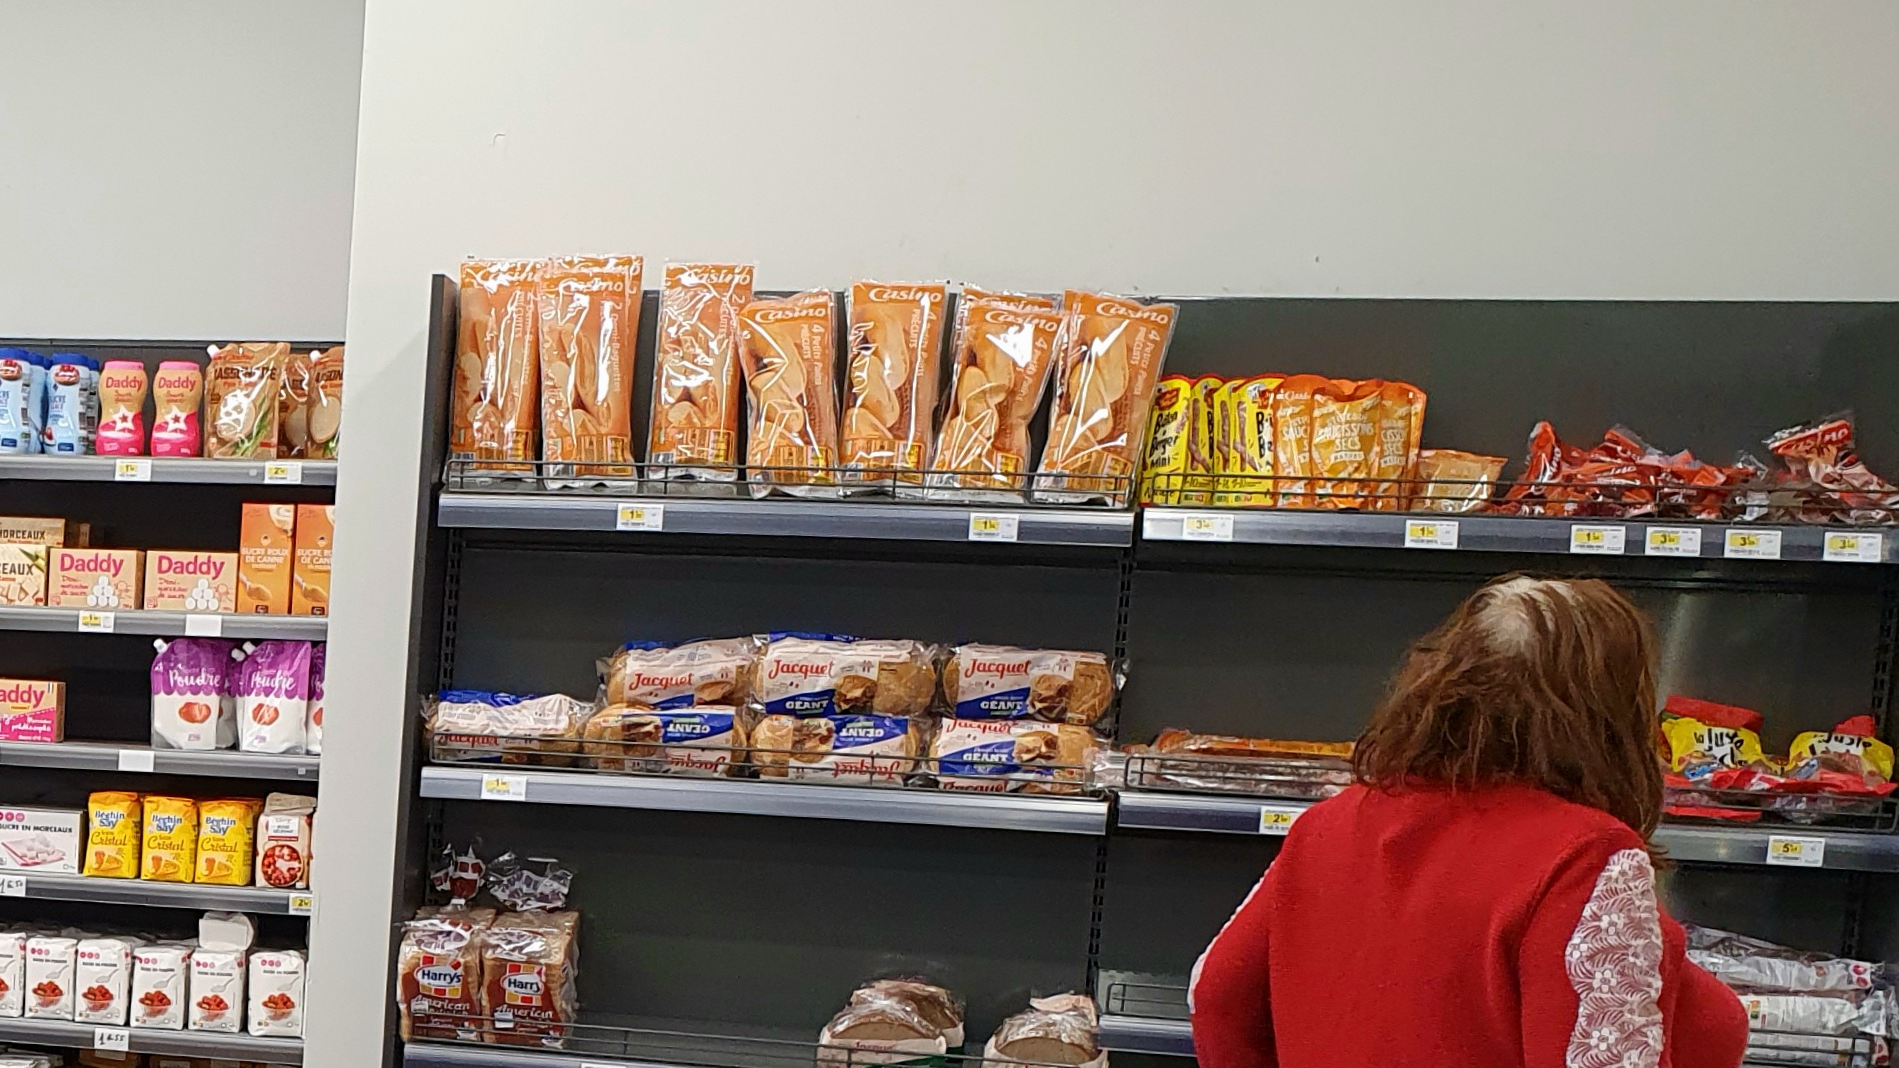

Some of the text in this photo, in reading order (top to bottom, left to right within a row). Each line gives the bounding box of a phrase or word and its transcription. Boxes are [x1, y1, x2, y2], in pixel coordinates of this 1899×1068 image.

[868, 286, 942, 304] Casino
[756, 305, 826, 325] Casino
[985, 307, 1058, 333] Casino
[1096, 300, 1169, 325] Casino
[105, 375, 143, 392] Daddy
[158, 375, 196, 392] Daddy
[1334, 438, 1361, 450] SECS
[59, 552, 124, 577] Daddy
[157, 554, 226, 581] Daddy
[245, 555, 284, 564] DE CANNE
[169, 665, 221, 688] Poudre
[768, 658, 835, 679] Jacquet
[964, 658, 1031, 678] Jacquet
[628, 671, 693, 691] Jacquet
[786, 700, 829, 711] GÉANT
[980, 699, 1023, 711] GÉANT
[666, 722, 711, 734] GÉANT
[839, 727, 884, 738] GÉANT
[99, 818, 118, 830] Say
[156, 822, 175, 835] Say
[90, 831, 128, 846] Cristal
[147, 835, 185, 852] Cristal
[201, 836, 238, 853] Cristal
[421, 969, 463, 984] Harry's
